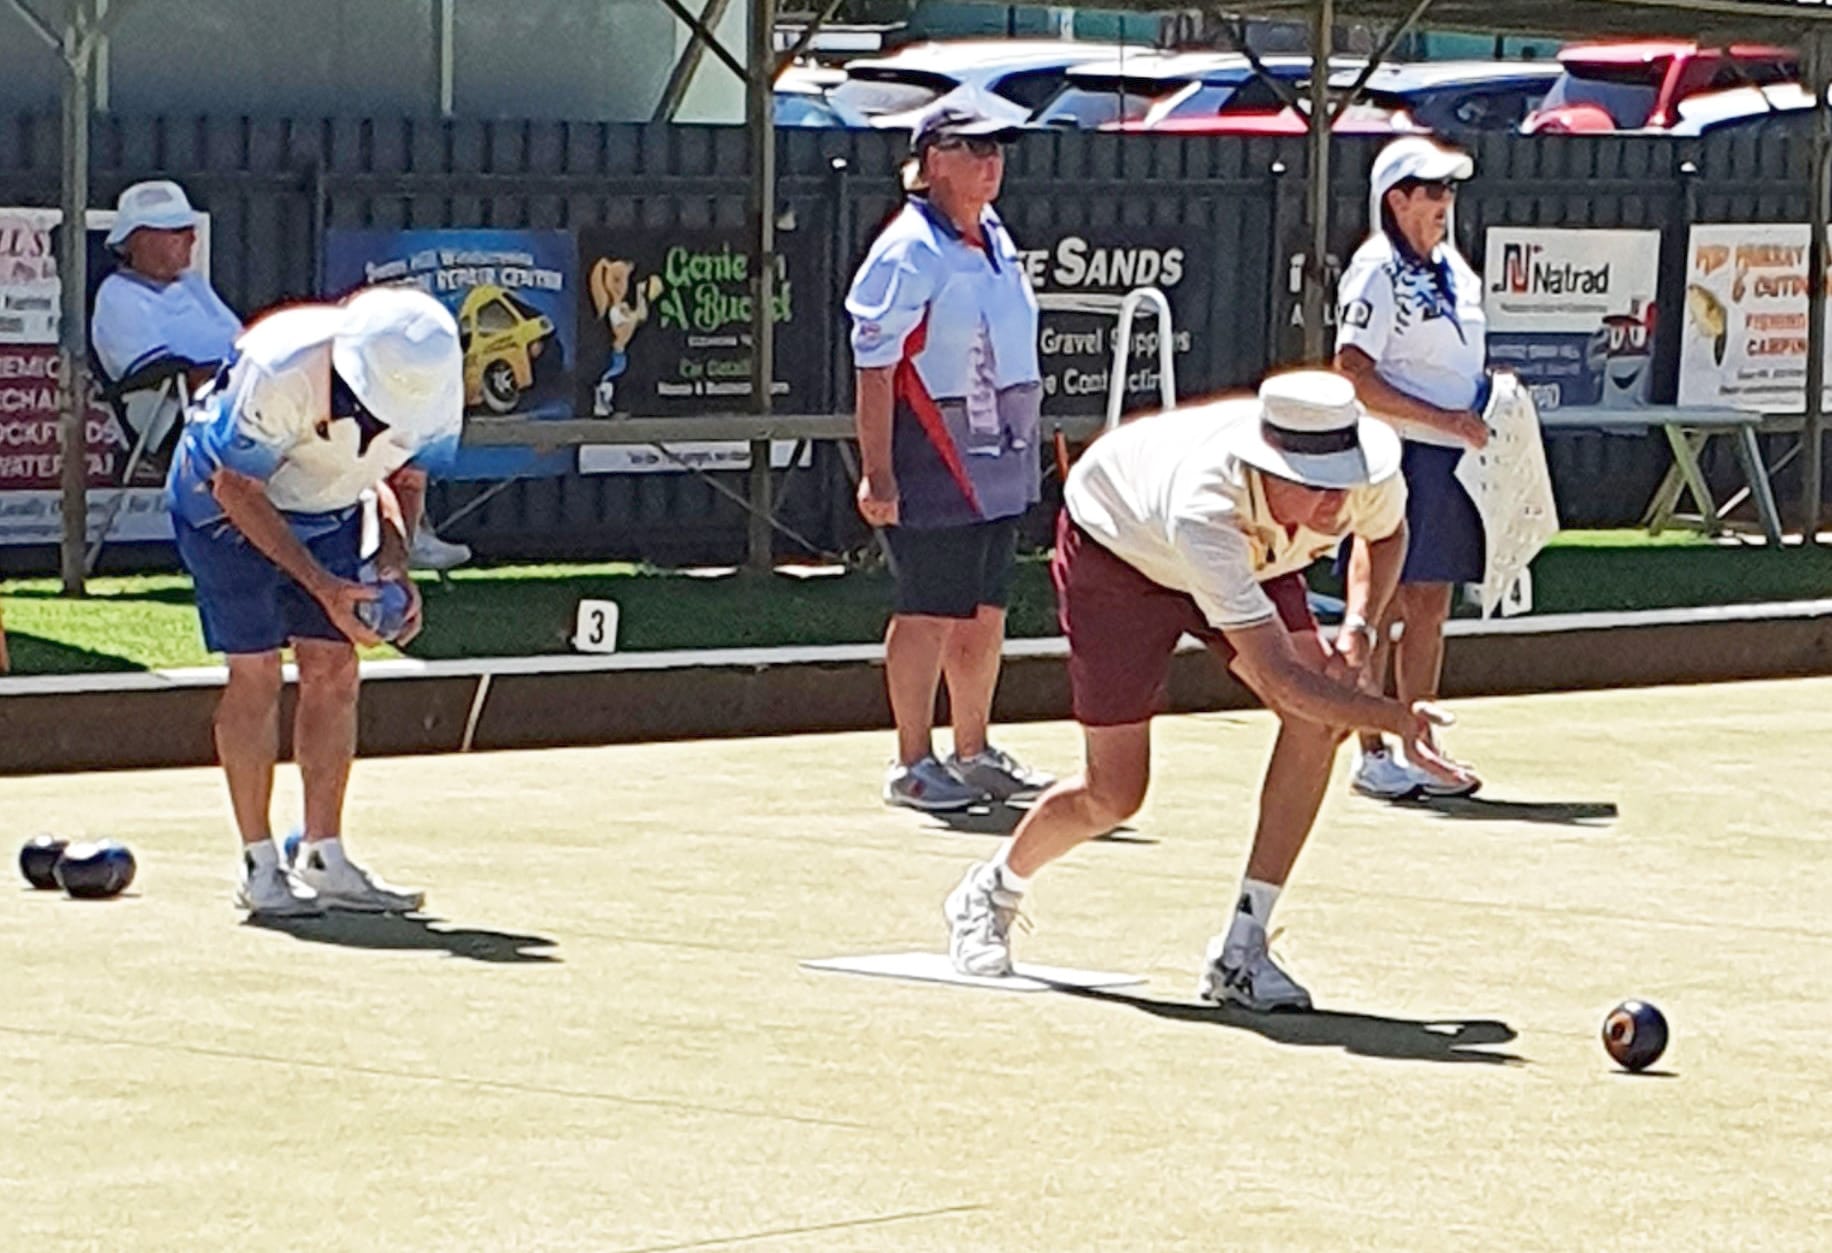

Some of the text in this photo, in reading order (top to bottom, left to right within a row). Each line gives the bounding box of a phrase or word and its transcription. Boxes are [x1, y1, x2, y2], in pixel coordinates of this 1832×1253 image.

[666, 241, 749, 287] Genie
[1054, 236, 1185, 286] SANDS
[1533, 262, 1610, 294] Natrad
[1041, 328, 1103, 354] Gravel
[589, 608, 605, 645] 3
